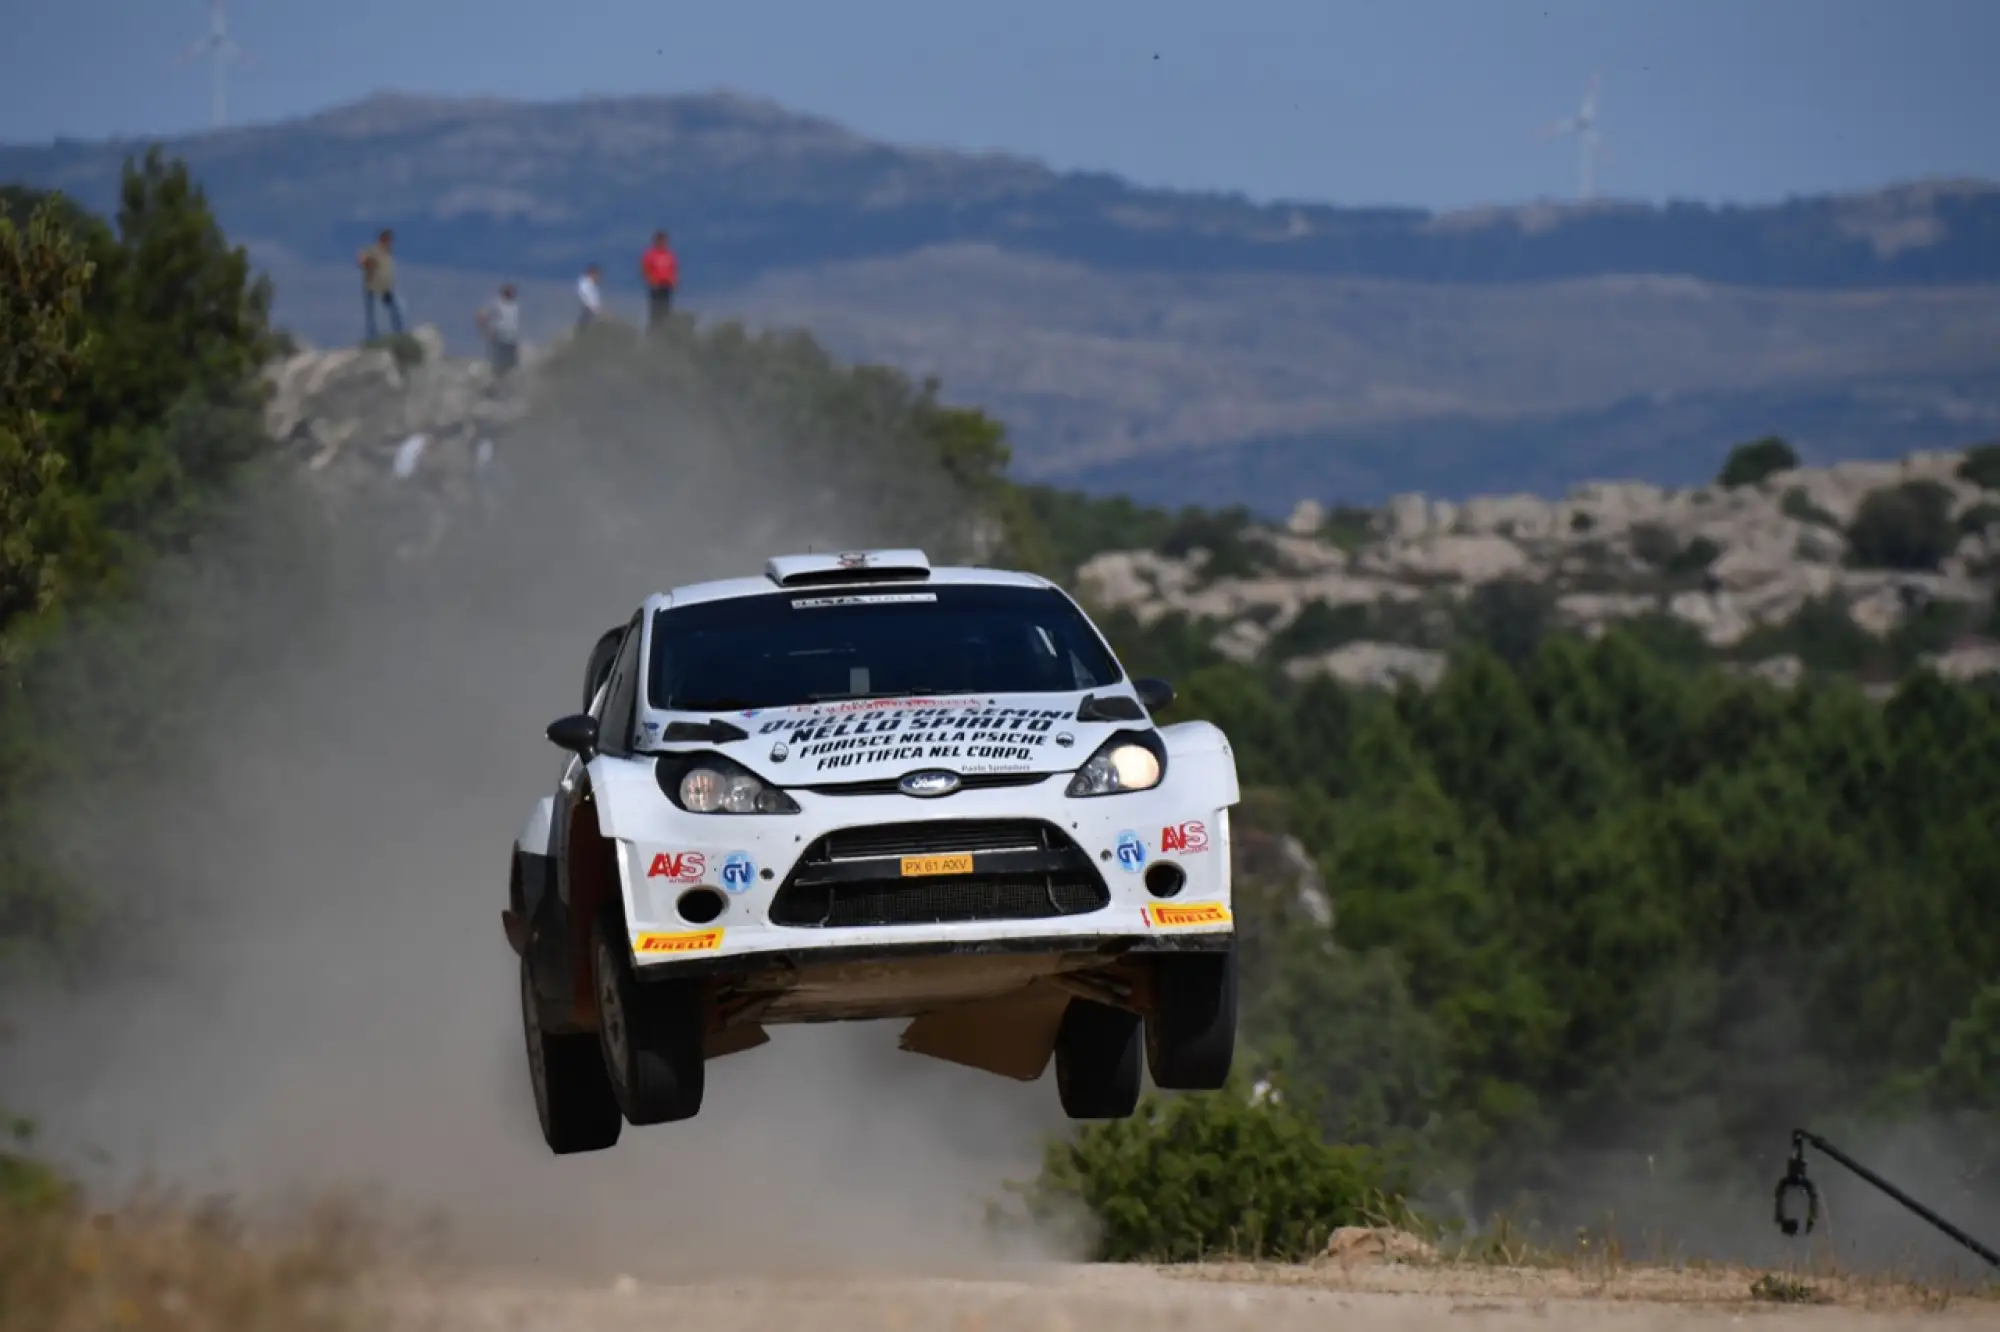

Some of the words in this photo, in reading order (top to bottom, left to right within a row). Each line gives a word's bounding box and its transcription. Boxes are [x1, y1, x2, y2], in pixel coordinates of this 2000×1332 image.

[788, 718, 902, 746] NELLO
[908, 715, 1054, 732] SPIRITO
[799, 733, 896, 759] FIORISCE
[899, 731, 966, 744] NELLA
[971, 731, 1047, 746] PSICHE
[816, 745, 924, 771] FRUTTIFICA
[929, 745, 962, 758] NEL
[966, 745, 1034, 761] CORPO.
[1161, 820, 1209, 852] AVS
[647, 850, 706, 878] AVS
[904, 861, 921, 873] PX
[924, 860, 939, 871] 61
[941, 858, 968, 870] AXV
[1155, 908, 1224, 924] PIRELLI
[641, 933, 717, 951] PIRELLI
